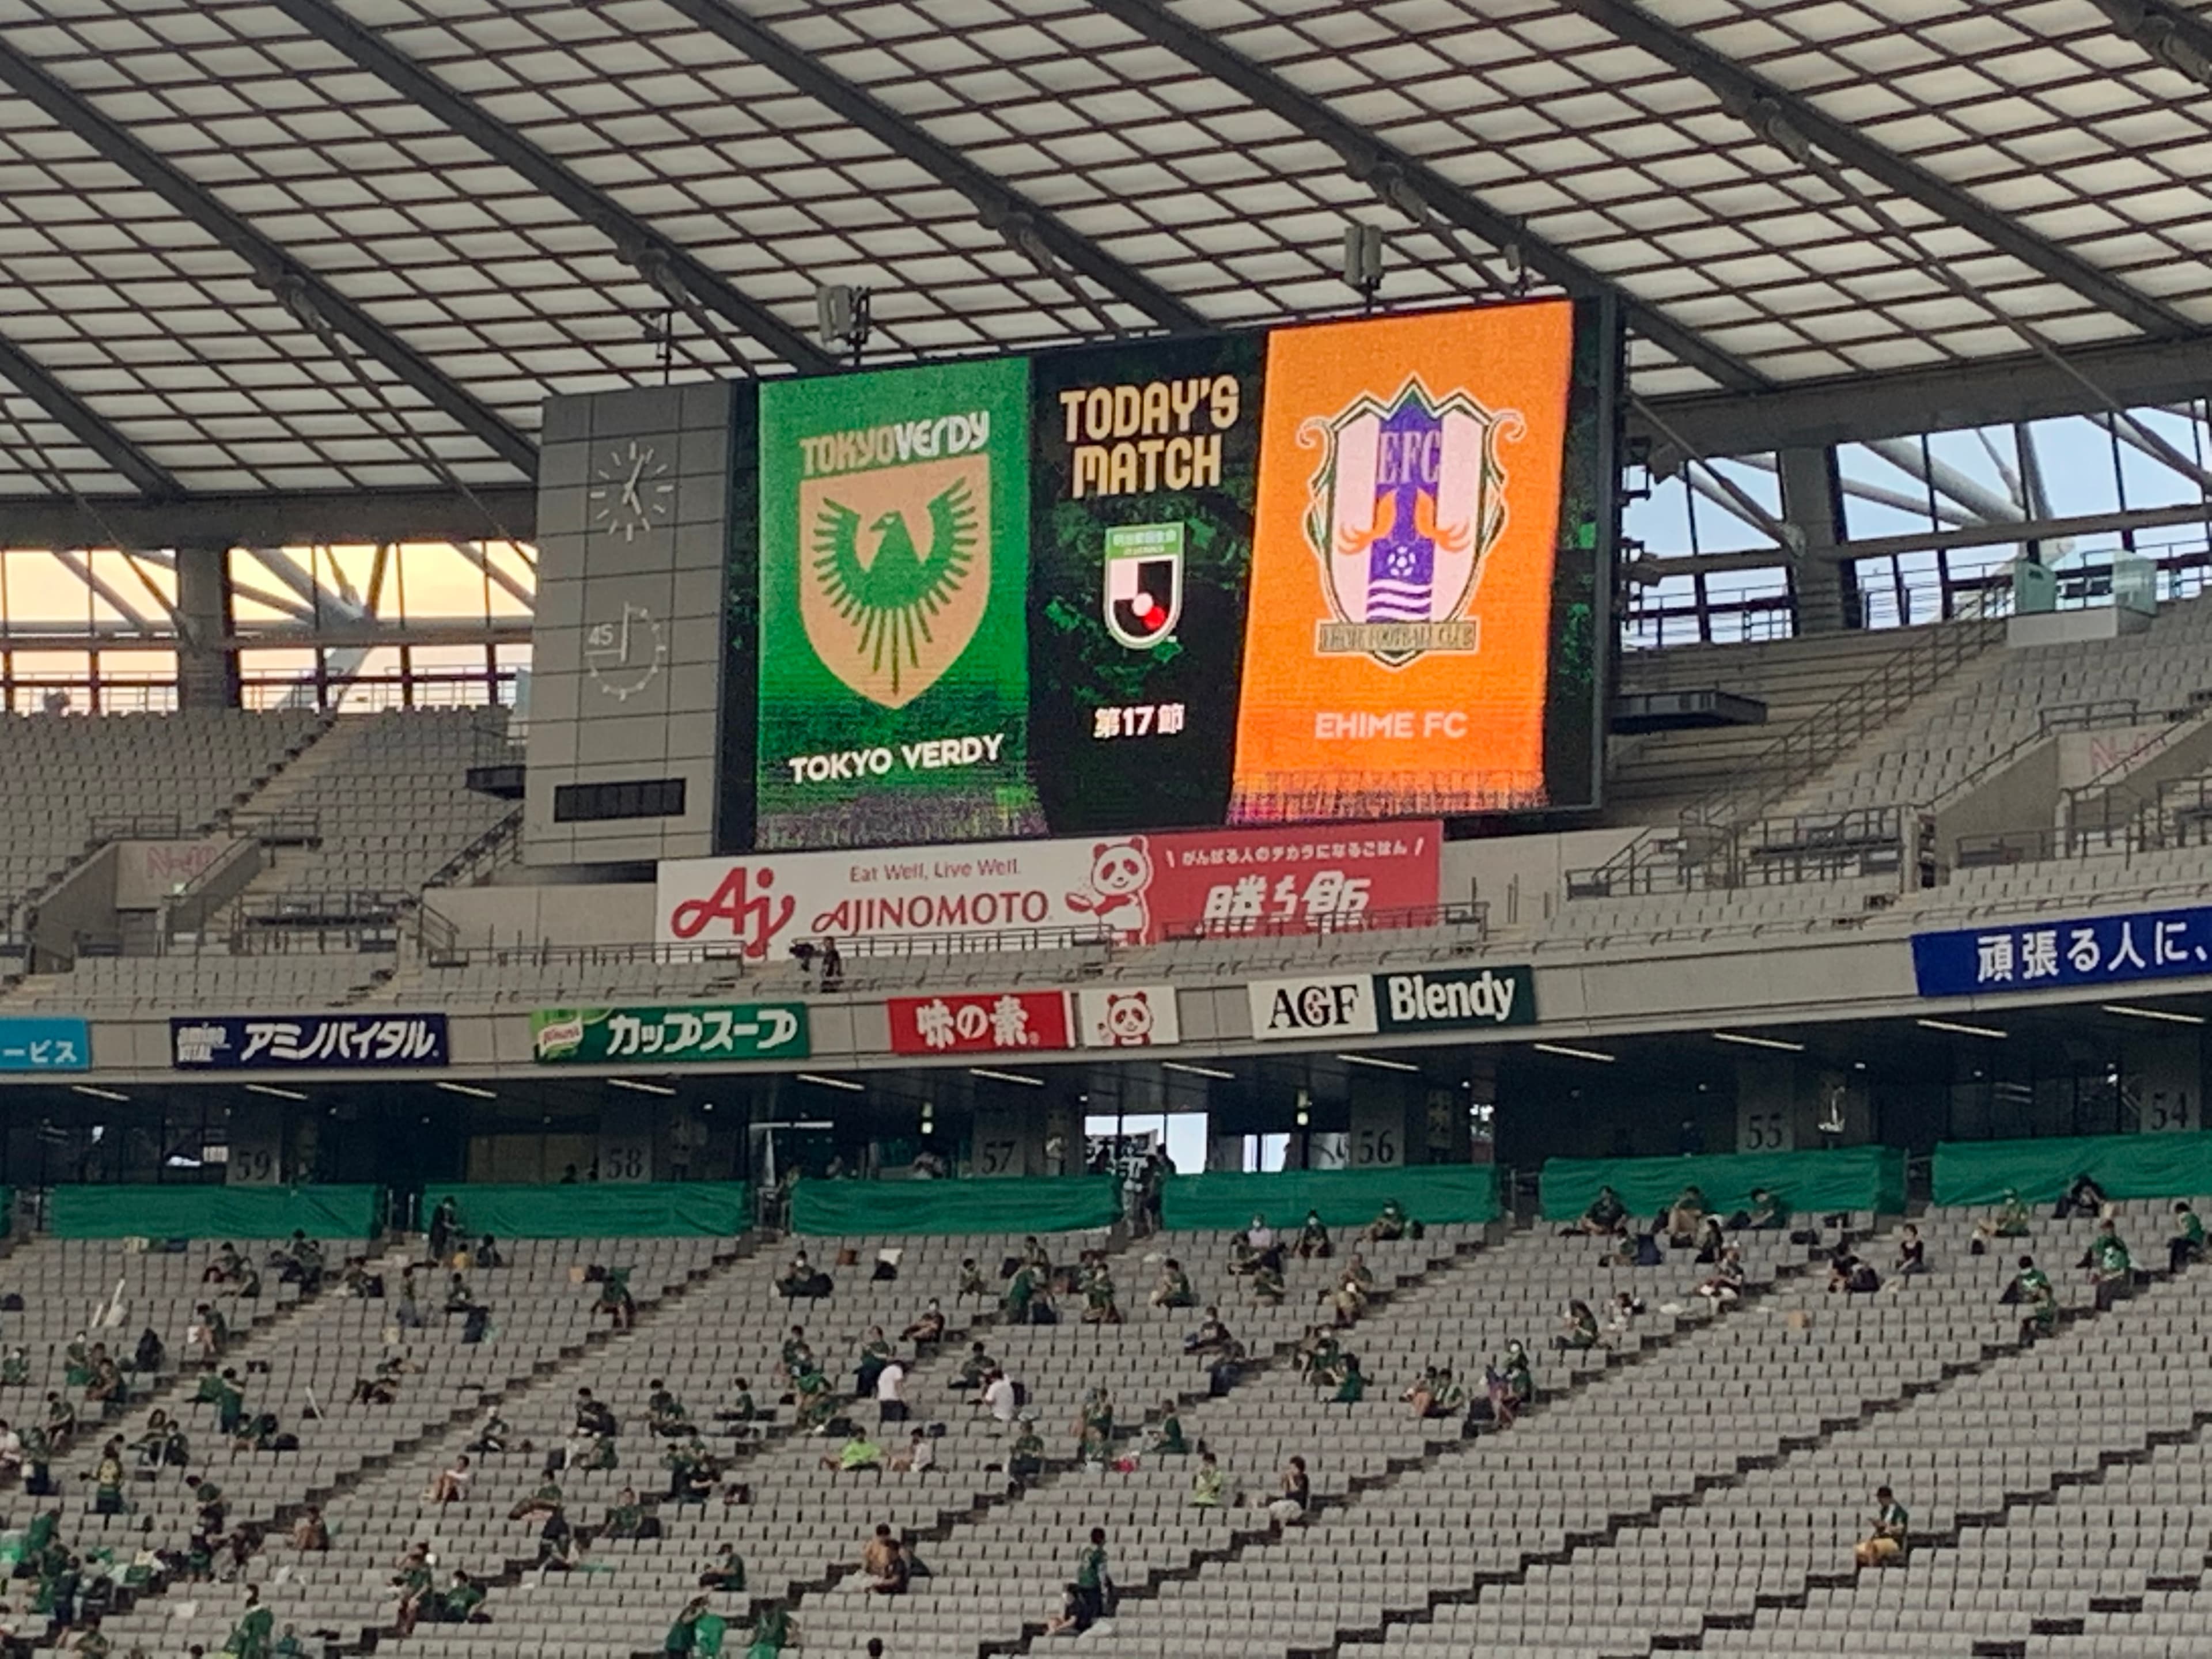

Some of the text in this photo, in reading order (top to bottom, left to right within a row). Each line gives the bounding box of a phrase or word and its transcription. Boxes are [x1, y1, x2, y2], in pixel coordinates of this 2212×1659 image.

[1059, 374, 1240, 442] TODAY'S
[1073, 433, 1221, 499] MATCH
[1376, 429, 1442, 484] EFC
[588, 623, 613, 646] 45
[1315, 711, 1468, 738] EHIME FC
[789, 733, 1005, 784] TOKYO VERDY
[850, 866, 878, 882] Eat
[884, 863, 928, 881] Well,
[934, 862, 973, 878] Live
[811, 890, 1048, 935] AJINOMOTO
[1978, 921, 2207, 982] 頑張る人に、
[1268, 984, 1359, 1029] AGF
[1388, 970, 1515, 1022] Blendy
[240, 1020, 436, 1061] アミノバイタル
[606, 1009, 798, 1055] カップスープ
[916, 995, 1029, 1050] 味の素
[1746, 1113, 1783, 1149] 55
[2151, 1092, 2188, 1130] 54
[236, 1151, 270, 1181] 59
[607, 1148, 642, 1179] 58
[982, 1140, 1016, 1174] 57
[1358, 1130, 1394, 1164] 56
